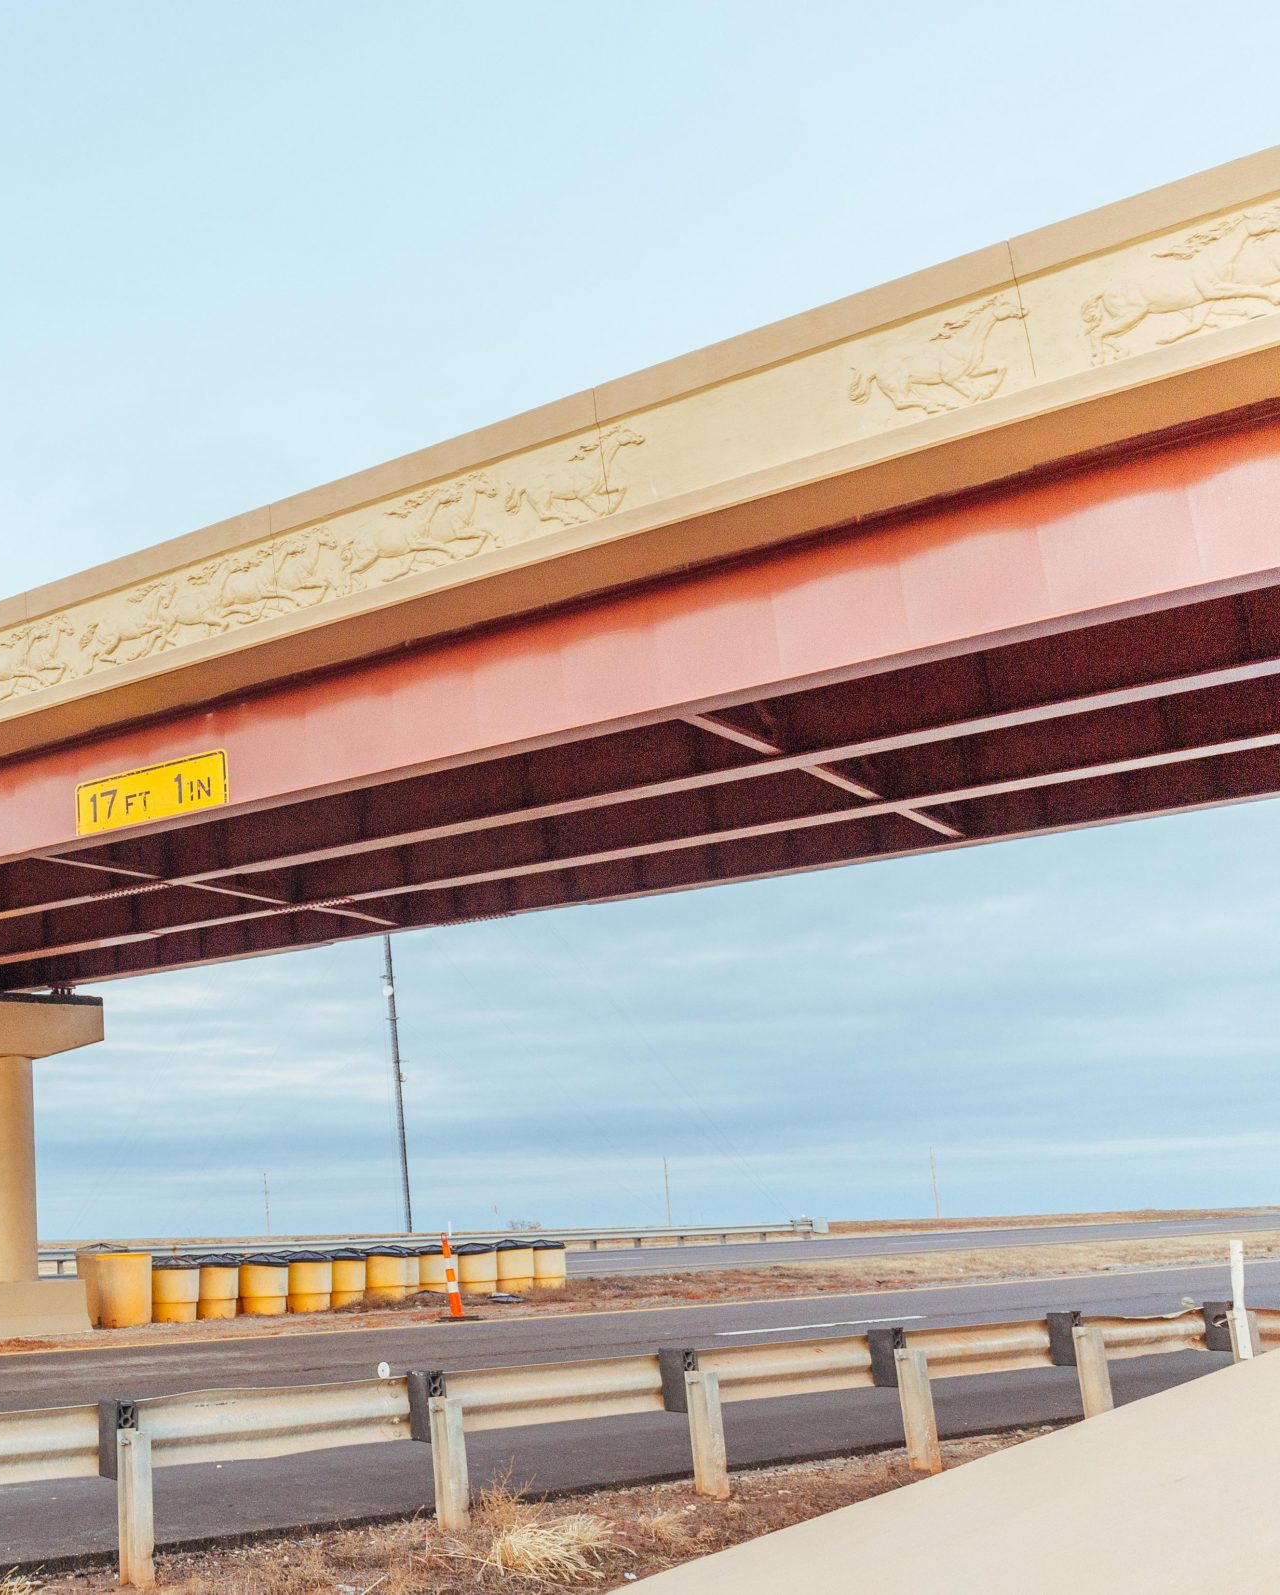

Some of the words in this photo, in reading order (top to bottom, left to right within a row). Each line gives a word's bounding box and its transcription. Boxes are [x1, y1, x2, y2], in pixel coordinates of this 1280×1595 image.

[90, 788, 117, 823] 17
[125, 791, 150, 816] FT
[173, 773, 183, 804] 1
[189, 776, 211, 802] IN
